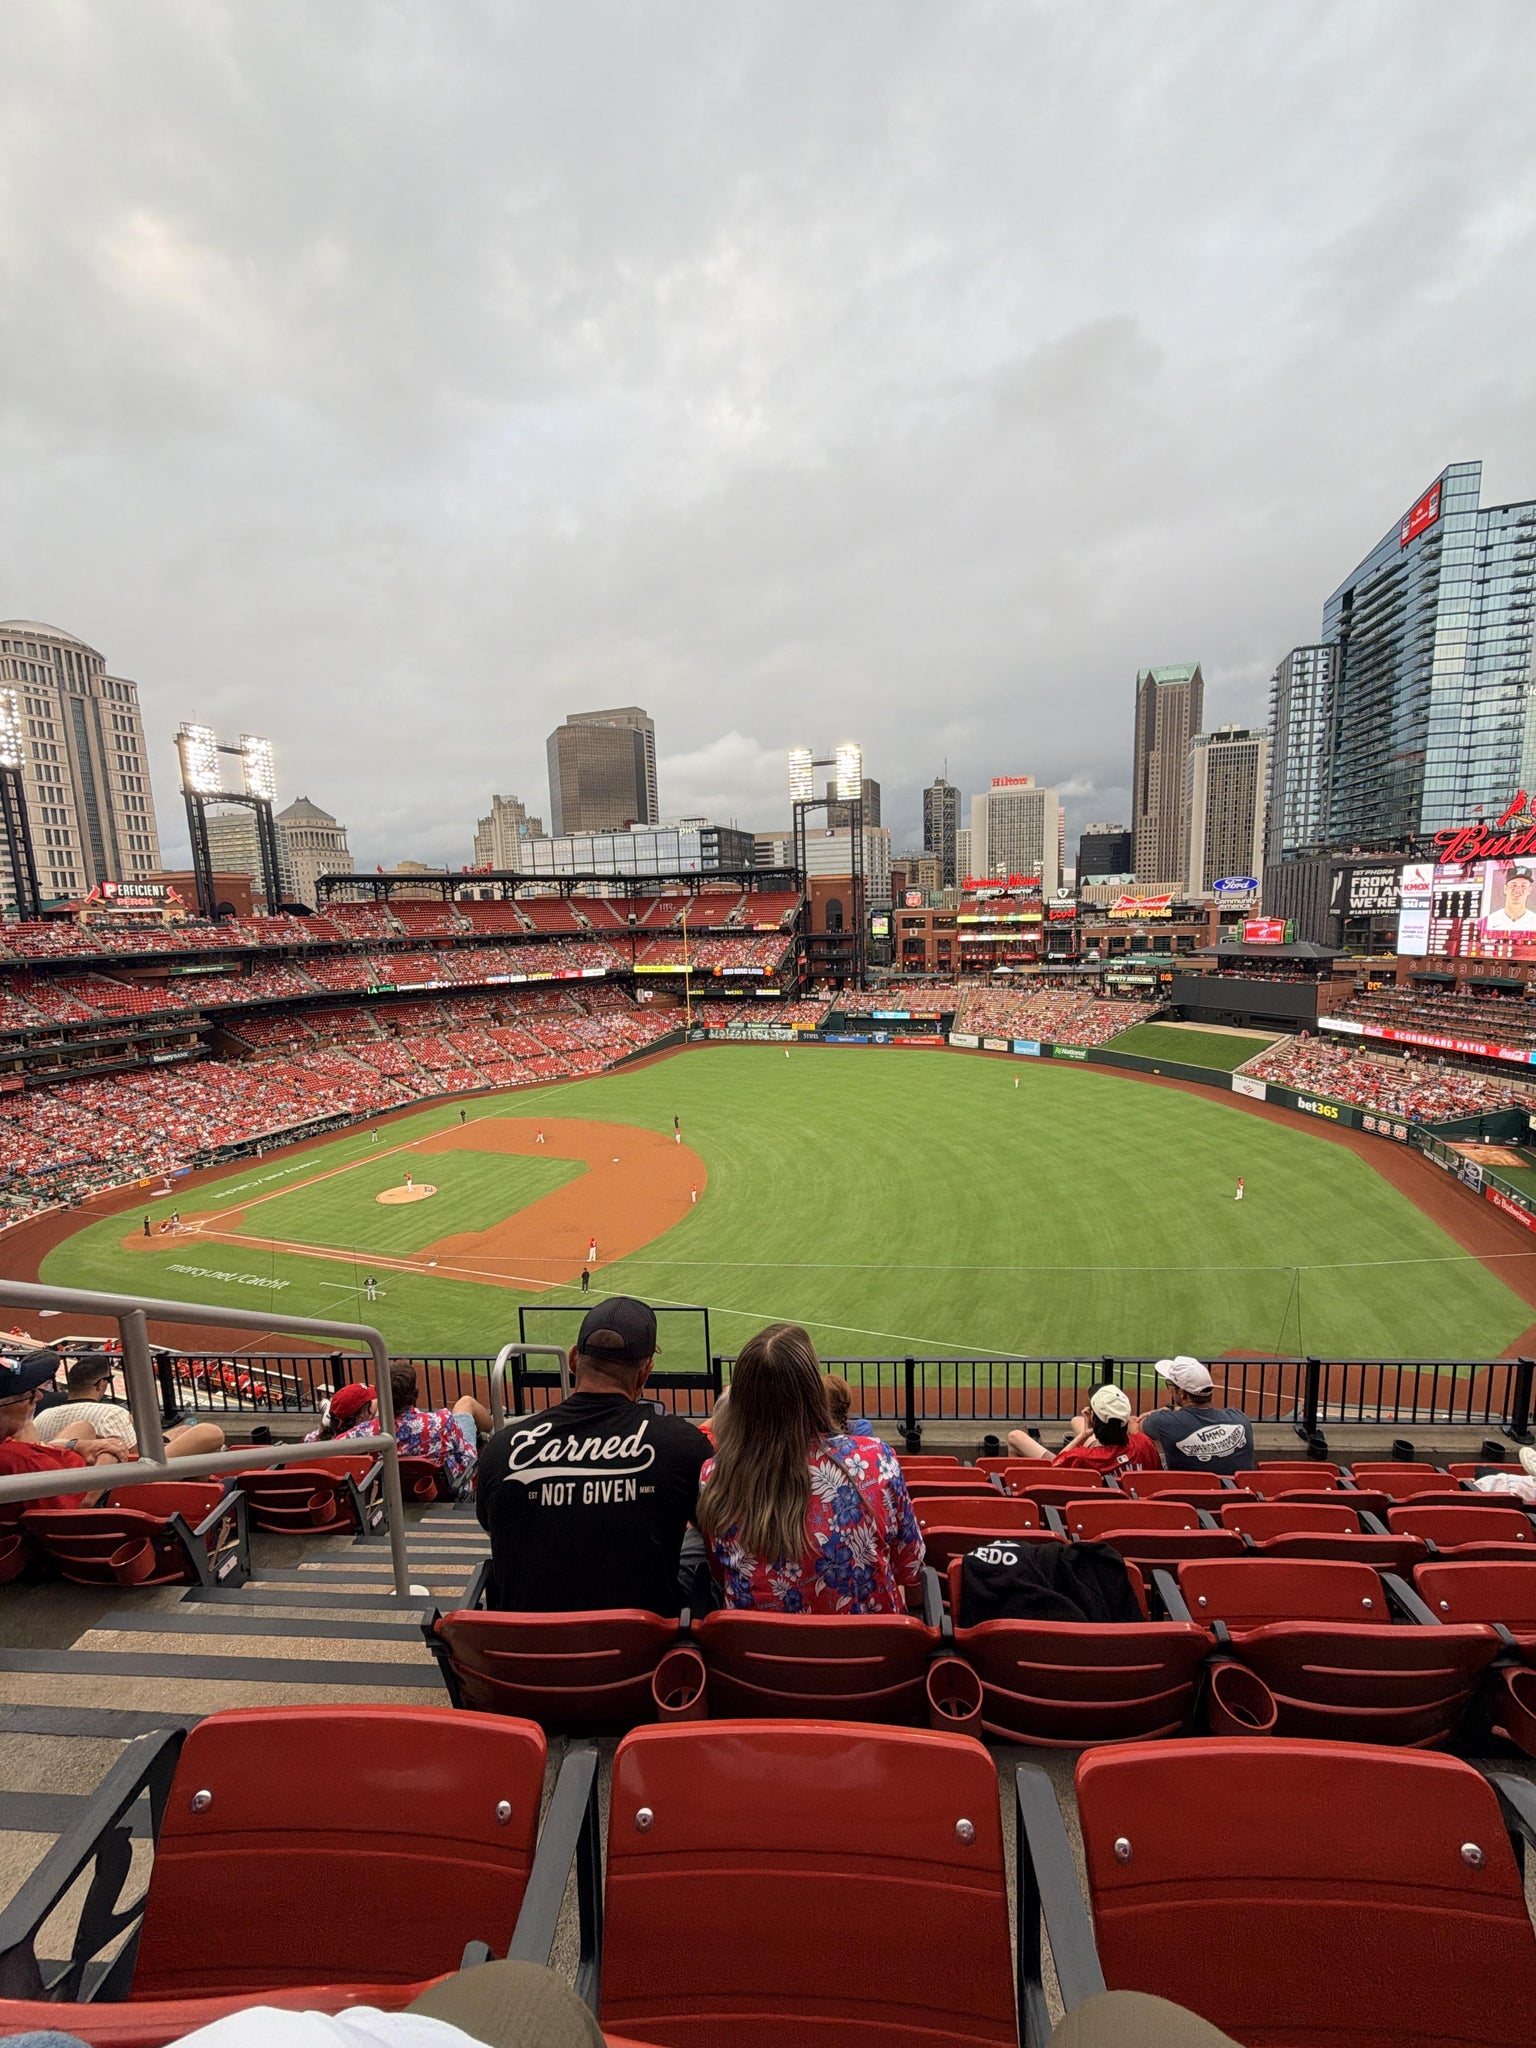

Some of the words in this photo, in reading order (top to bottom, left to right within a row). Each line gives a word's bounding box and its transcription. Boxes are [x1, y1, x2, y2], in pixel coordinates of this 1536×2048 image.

[992, 776, 1028, 787] Hilton
[1434, 825, 1536, 864] Bud
[1222, 879, 1249, 890] Ford
[1351, 876, 1393, 888] FROM
[1351, 888, 1379, 898] LOU
[1382, 887, 1402, 898] AN
[1110, 899, 1171, 909] Budweiser
[1214, 898, 1257, 906] Community
[1350, 898, 1397, 908] WE'RE
[1109, 910, 1137, 918] BREW
[1139, 909, 1172, 917] HOUSE
[1509, 966, 1521, 978] 17
[1527, 968, 1536, 980] 2
[1394, 1032, 1453, 1048] SCOREBOARD
[1456, 1042, 1486, 1054] PATIO
[1298, 1097, 1338, 1119] bet365
[508, 1420, 655, 1470] Earned
[541, 1483, 576, 1506] NOT
[583, 1478, 636, 1505] GIVEN
[640, 1486, 655, 1494] MMIX
